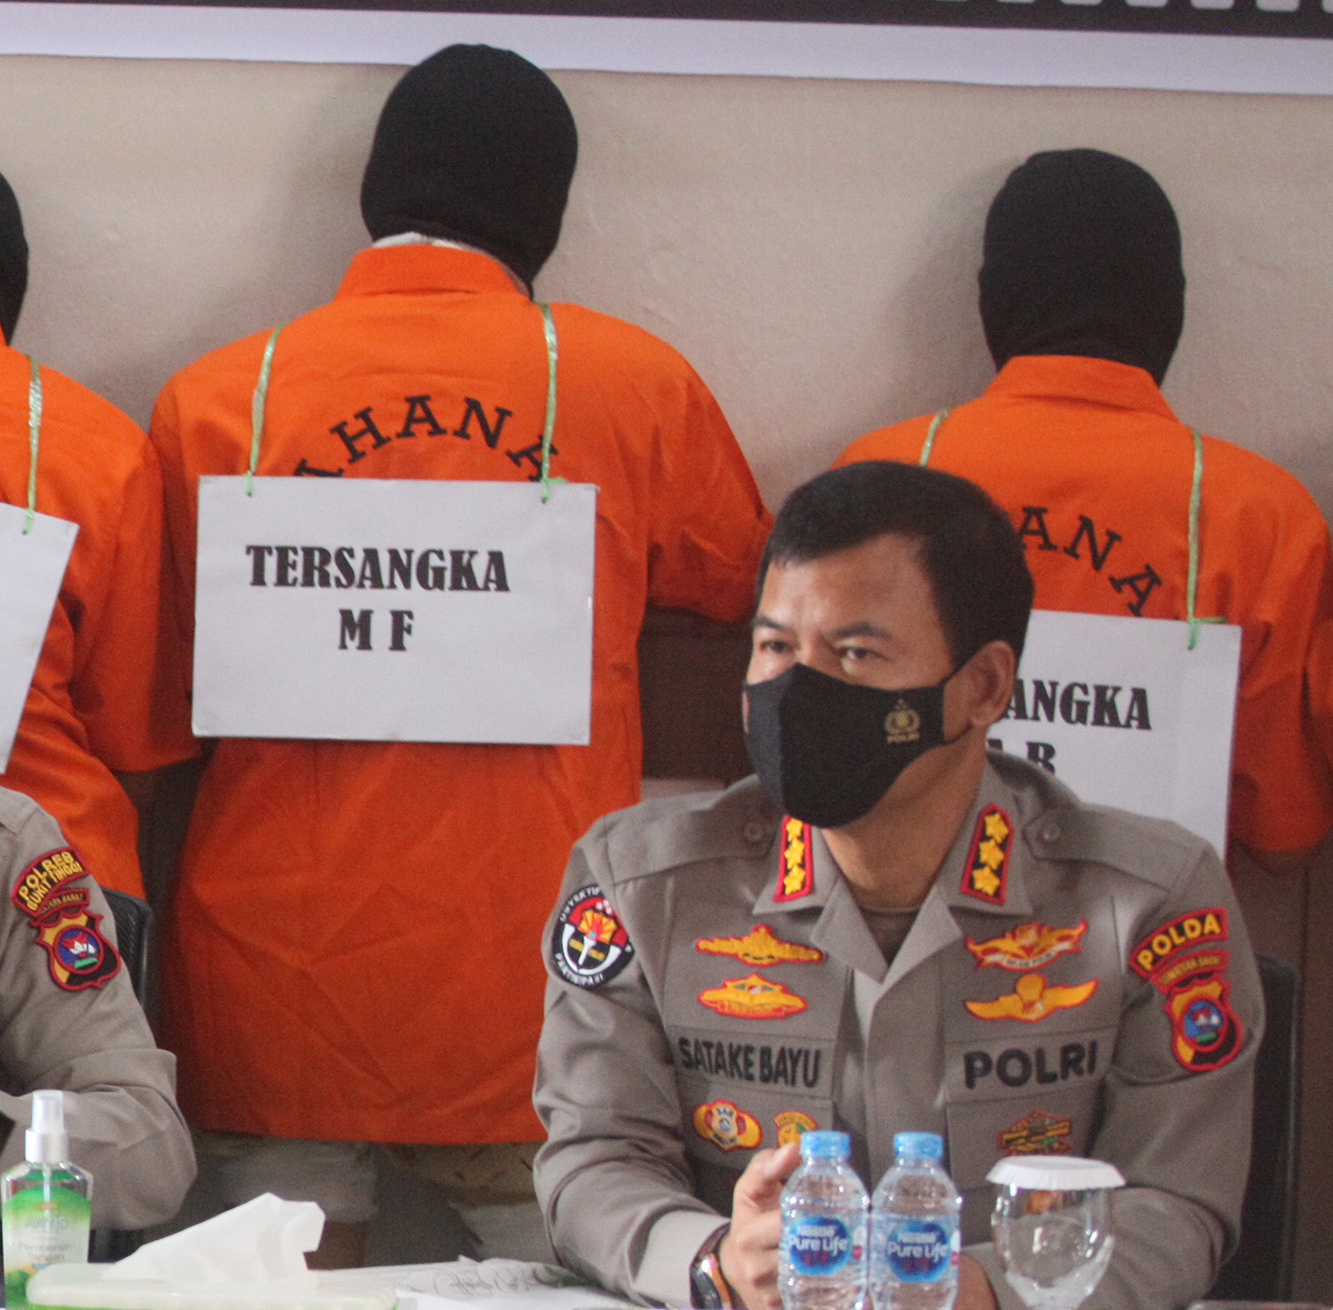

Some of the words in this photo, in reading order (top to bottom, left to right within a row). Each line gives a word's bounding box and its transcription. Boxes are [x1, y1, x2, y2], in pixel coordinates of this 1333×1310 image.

[245, 545, 510, 592] TERSANGKA
[338, 608, 374, 651] M
[389, 609, 414, 651] F
[18, 850, 75, 901] POLRES
[1136, 912, 1221, 972] POLDA
[678, 1036, 754, 1083] SATAKE
[759, 1045, 822, 1088] BAYU
[963, 1040, 1098, 1090] POLRI
[789, 1235, 821, 1252] Pure
[822, 1238, 849, 1257] Life
[887, 1241, 923, 1258] Pure
[924, 1243, 949, 1264] Life
